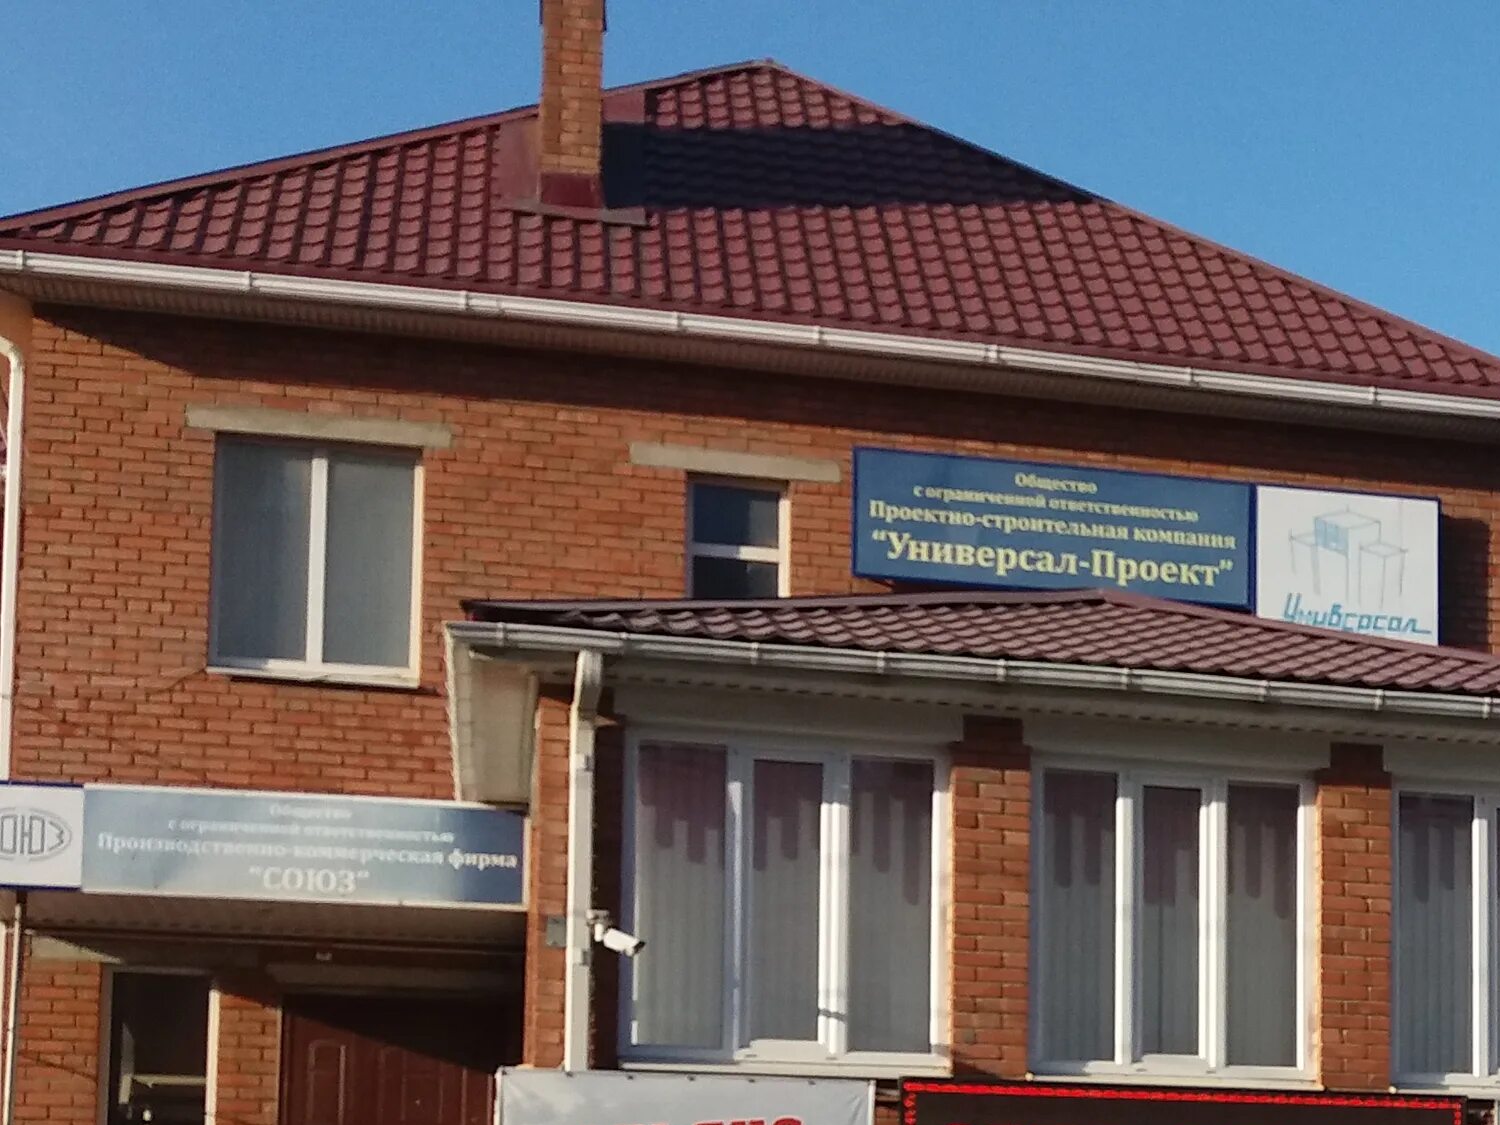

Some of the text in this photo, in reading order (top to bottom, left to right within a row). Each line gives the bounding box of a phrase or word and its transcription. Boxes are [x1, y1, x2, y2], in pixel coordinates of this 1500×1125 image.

[1014, 471, 1098, 494] Общество
[912, 484, 1199, 522] с ограниченной ответственностью
[869, 499, 1237, 549] Проектно-строительная компания
[448, 848, 518, 870] фирма
